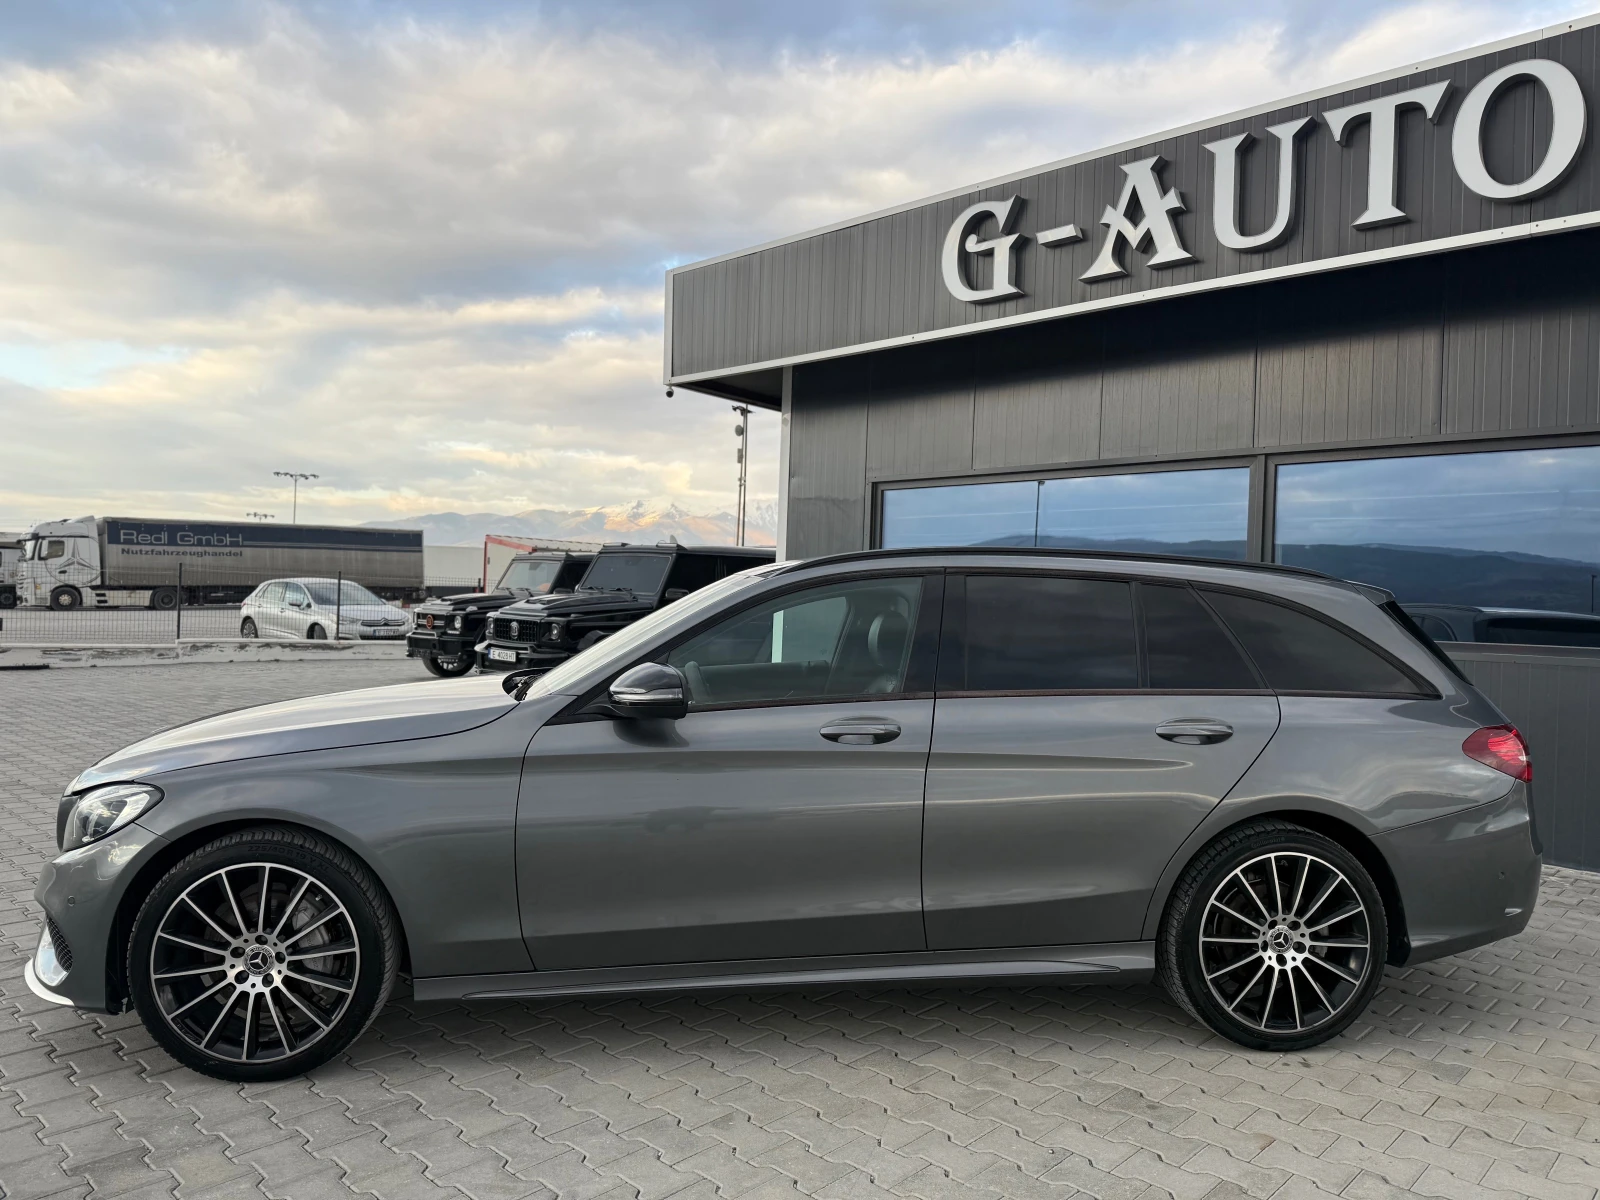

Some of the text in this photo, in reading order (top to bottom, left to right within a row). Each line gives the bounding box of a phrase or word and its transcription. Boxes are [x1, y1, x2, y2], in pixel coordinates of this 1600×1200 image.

[942, 58, 1587, 304] G-AUTO
[120, 529, 243, 545] Redl GmbH
[121, 548, 243, 558] Nutzfahrzeughandel
[247, 845, 285, 854] 225/40
